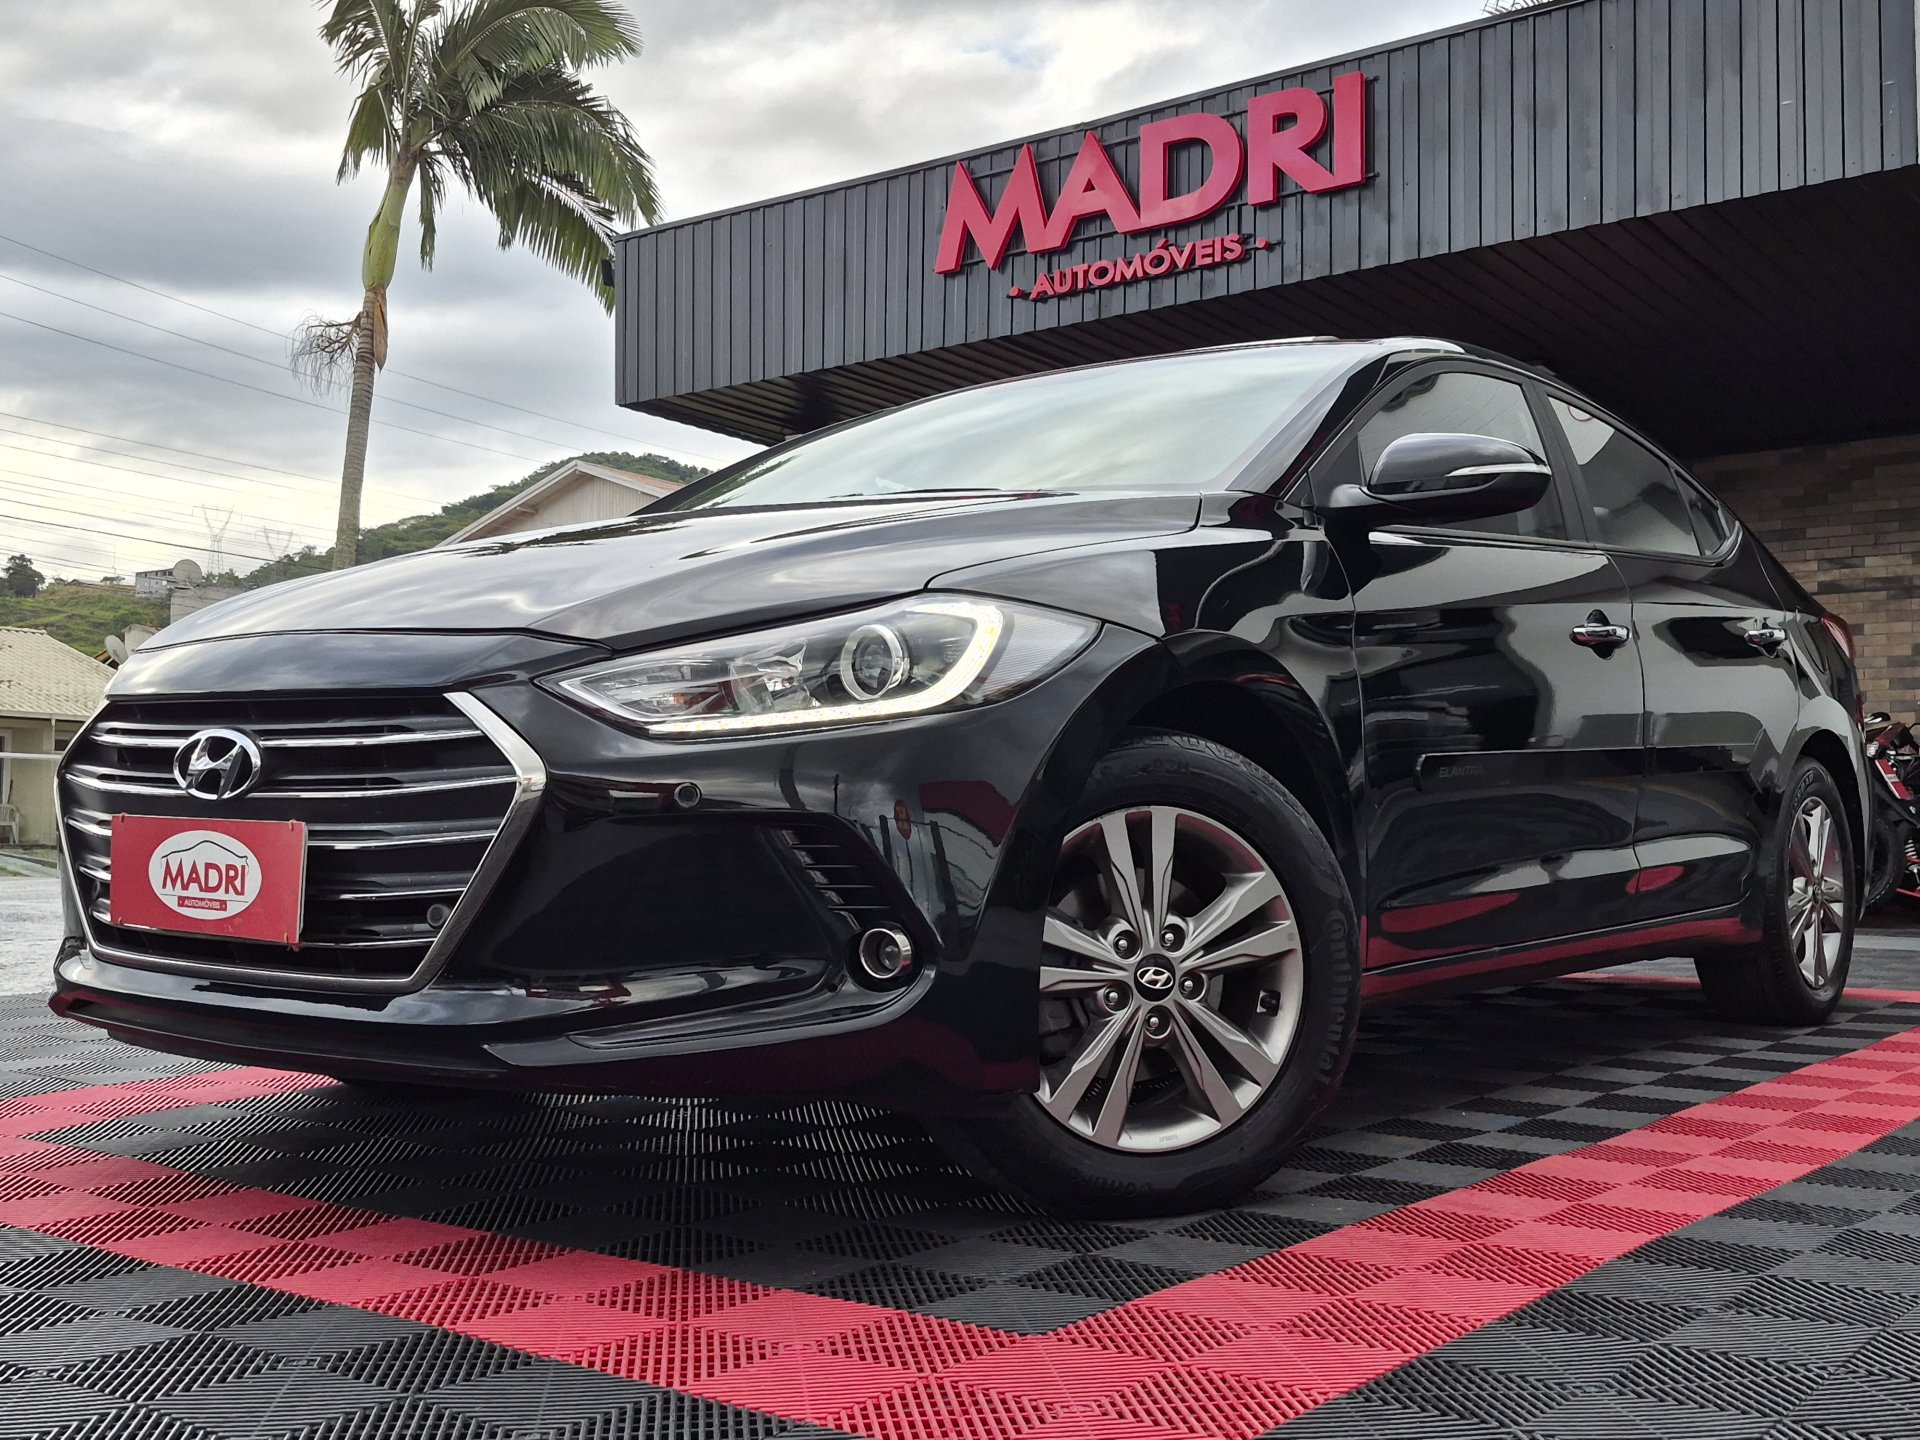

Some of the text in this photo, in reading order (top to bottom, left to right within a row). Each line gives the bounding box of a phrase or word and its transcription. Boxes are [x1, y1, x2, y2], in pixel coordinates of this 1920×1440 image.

[933, 70, 1366, 275] MADRI
[1029, 233, 1246, 299] AUTOMÓVEIS
[162, 857, 246, 896] MADRI
